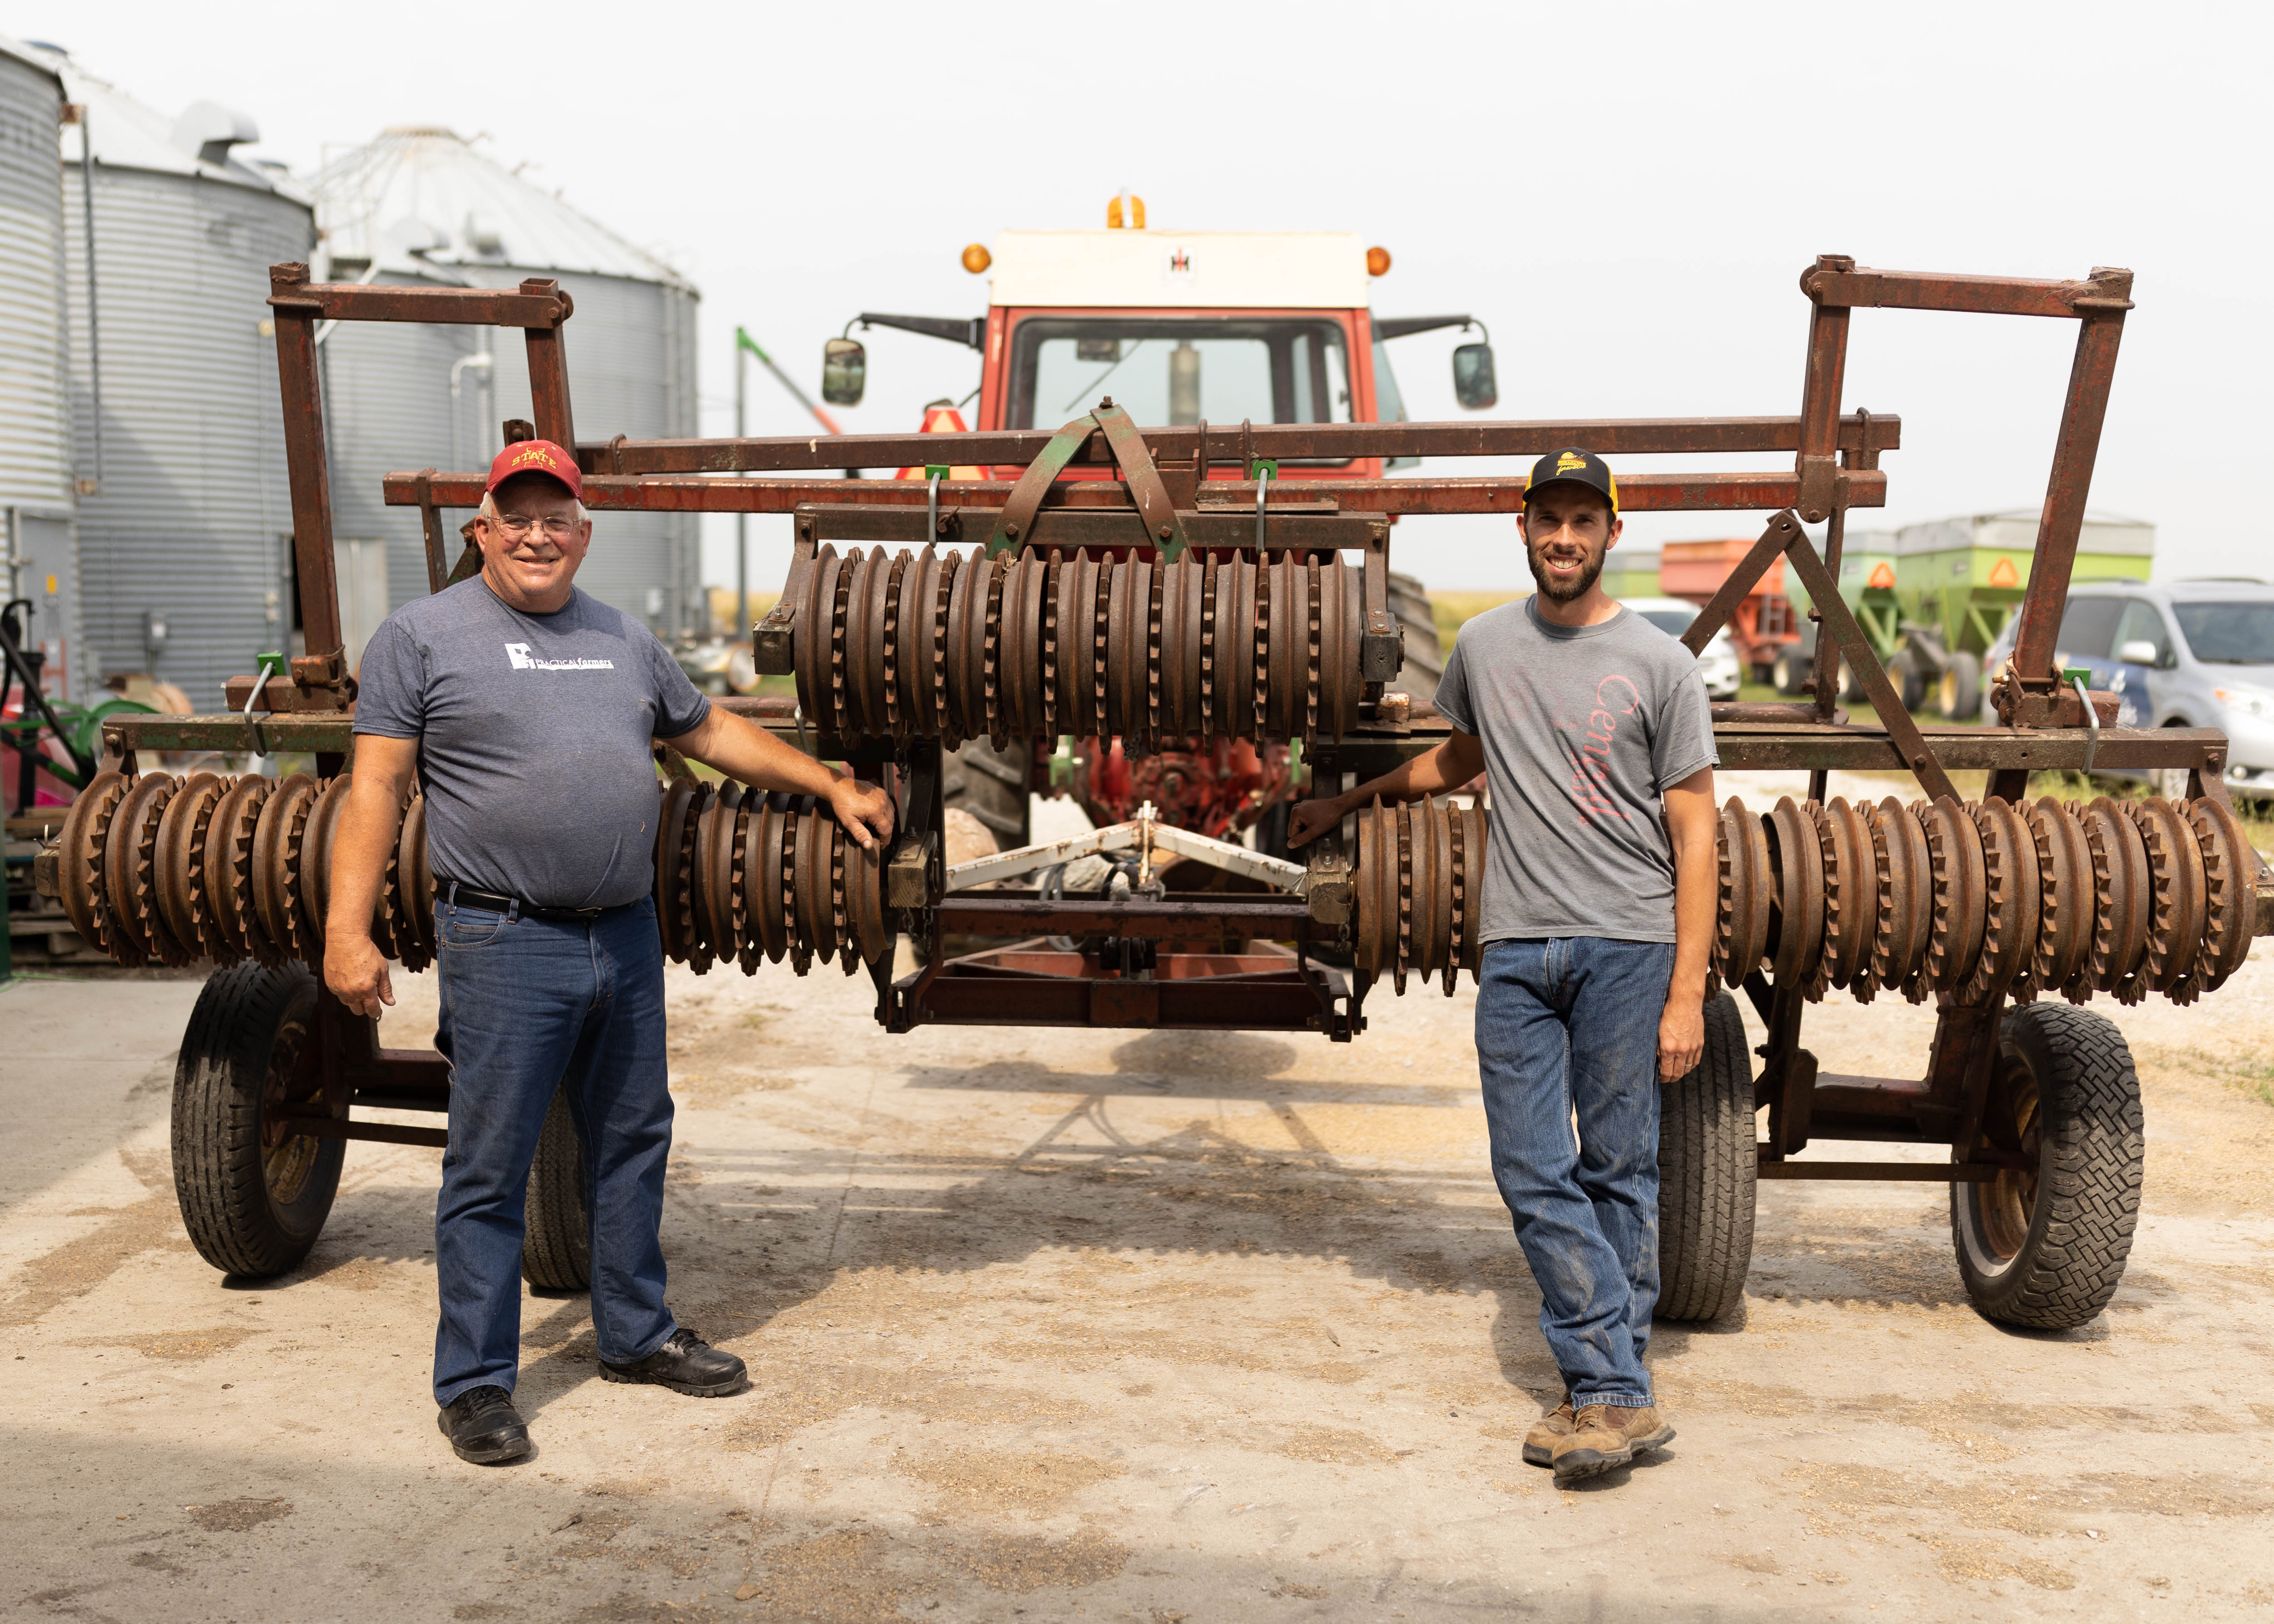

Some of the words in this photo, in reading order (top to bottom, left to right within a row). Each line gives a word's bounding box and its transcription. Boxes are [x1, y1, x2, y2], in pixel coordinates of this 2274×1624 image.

[512, 452, 556, 468] STATE
[536, 659, 578, 667] PRACTICAL
[577, 657, 612, 669] farmers
[1581, 674, 1639, 821] Central
